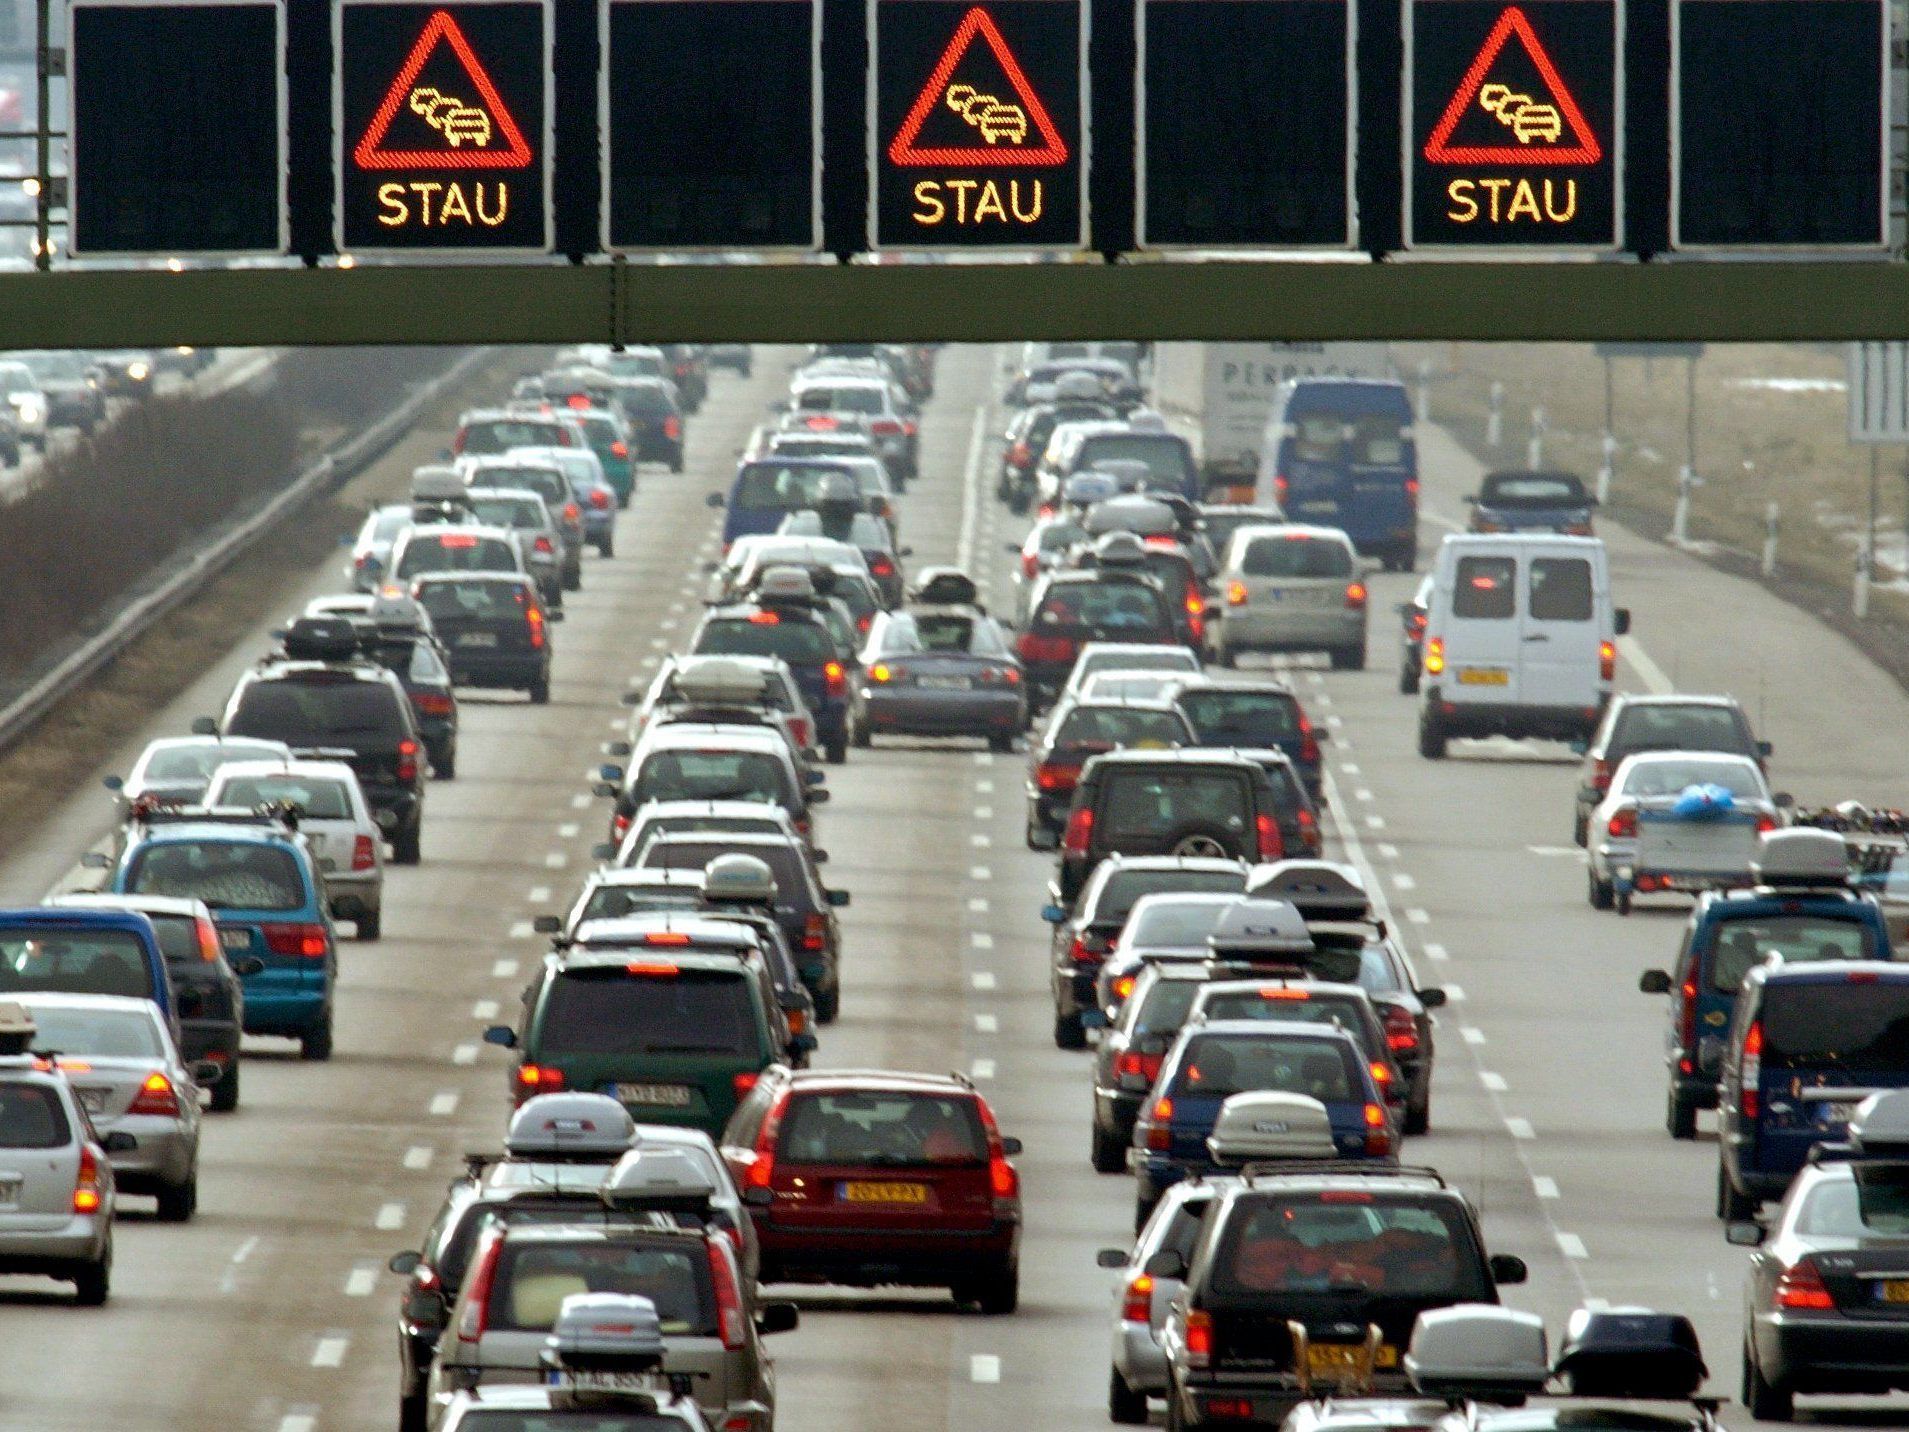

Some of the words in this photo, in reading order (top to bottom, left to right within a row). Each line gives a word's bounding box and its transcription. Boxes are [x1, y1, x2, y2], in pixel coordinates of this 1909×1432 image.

[378, 182, 507, 227] STAU
[912, 179, 1042, 225] STAU
[1447, 177, 1577, 224] STAU
